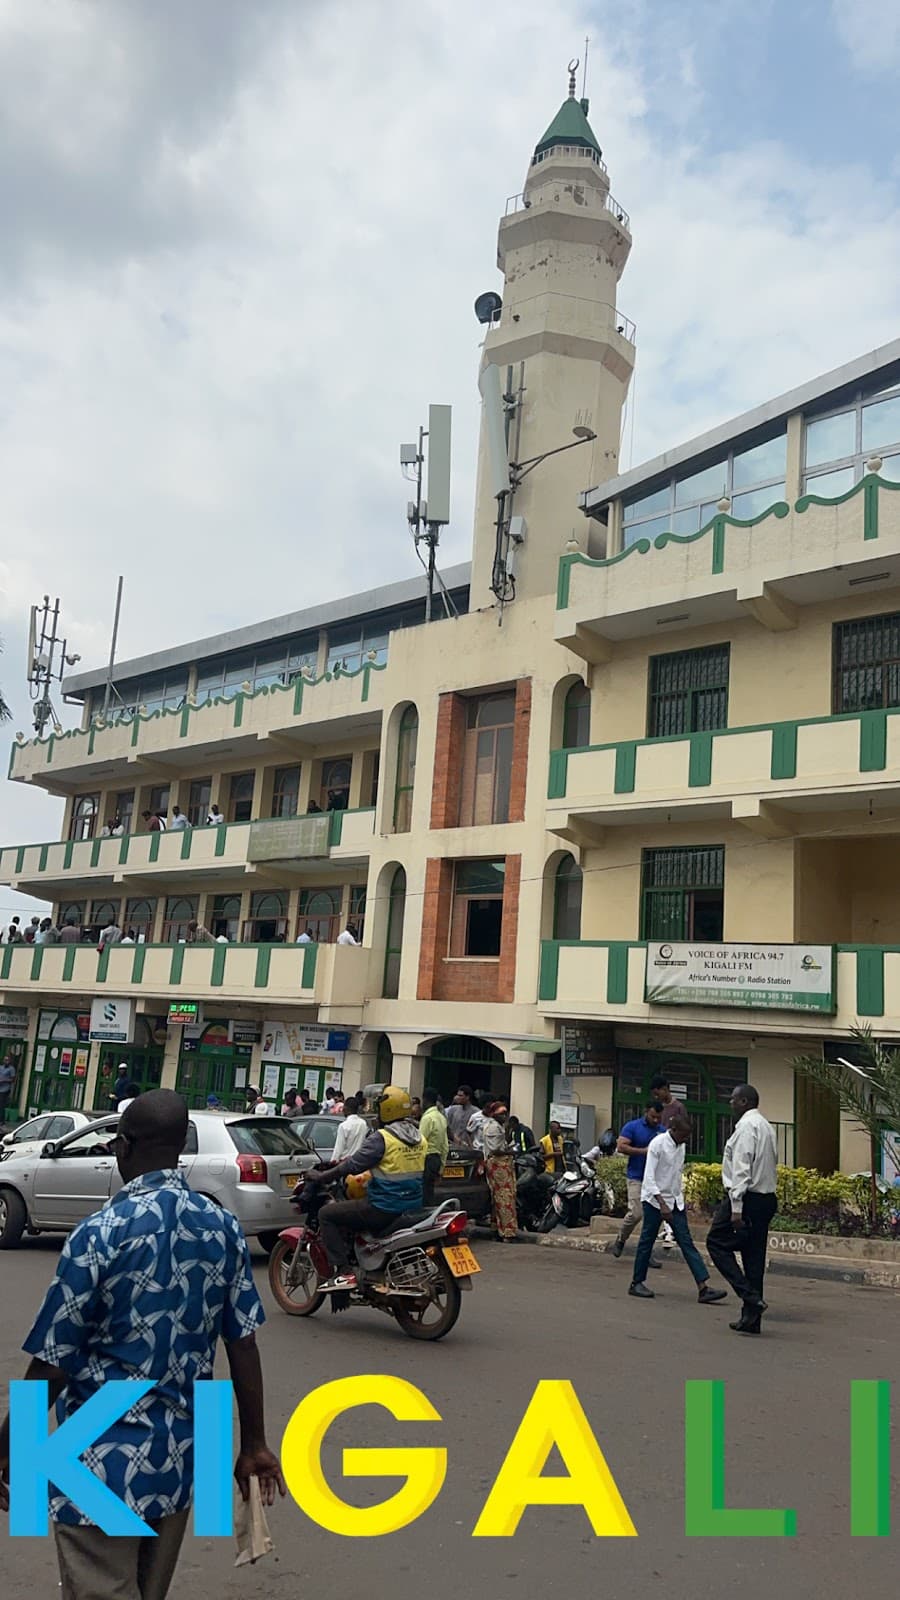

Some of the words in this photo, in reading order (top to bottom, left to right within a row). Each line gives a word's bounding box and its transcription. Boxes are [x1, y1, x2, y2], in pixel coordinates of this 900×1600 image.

[688, 950, 715, 959] VOICE
[716, 951, 729, 959] OF
[731, 951, 766, 960] AFRICA
[767, 952, 784, 960] 94.7
[704, 961, 736, 970] KIGALI
[738, 962, 752, 970] FM
[688, 973, 711, 983] Africa's
[712, 975, 737, 983] Number
[747, 975, 766, 984] Radio
[767, 976, 791, 985] Station
